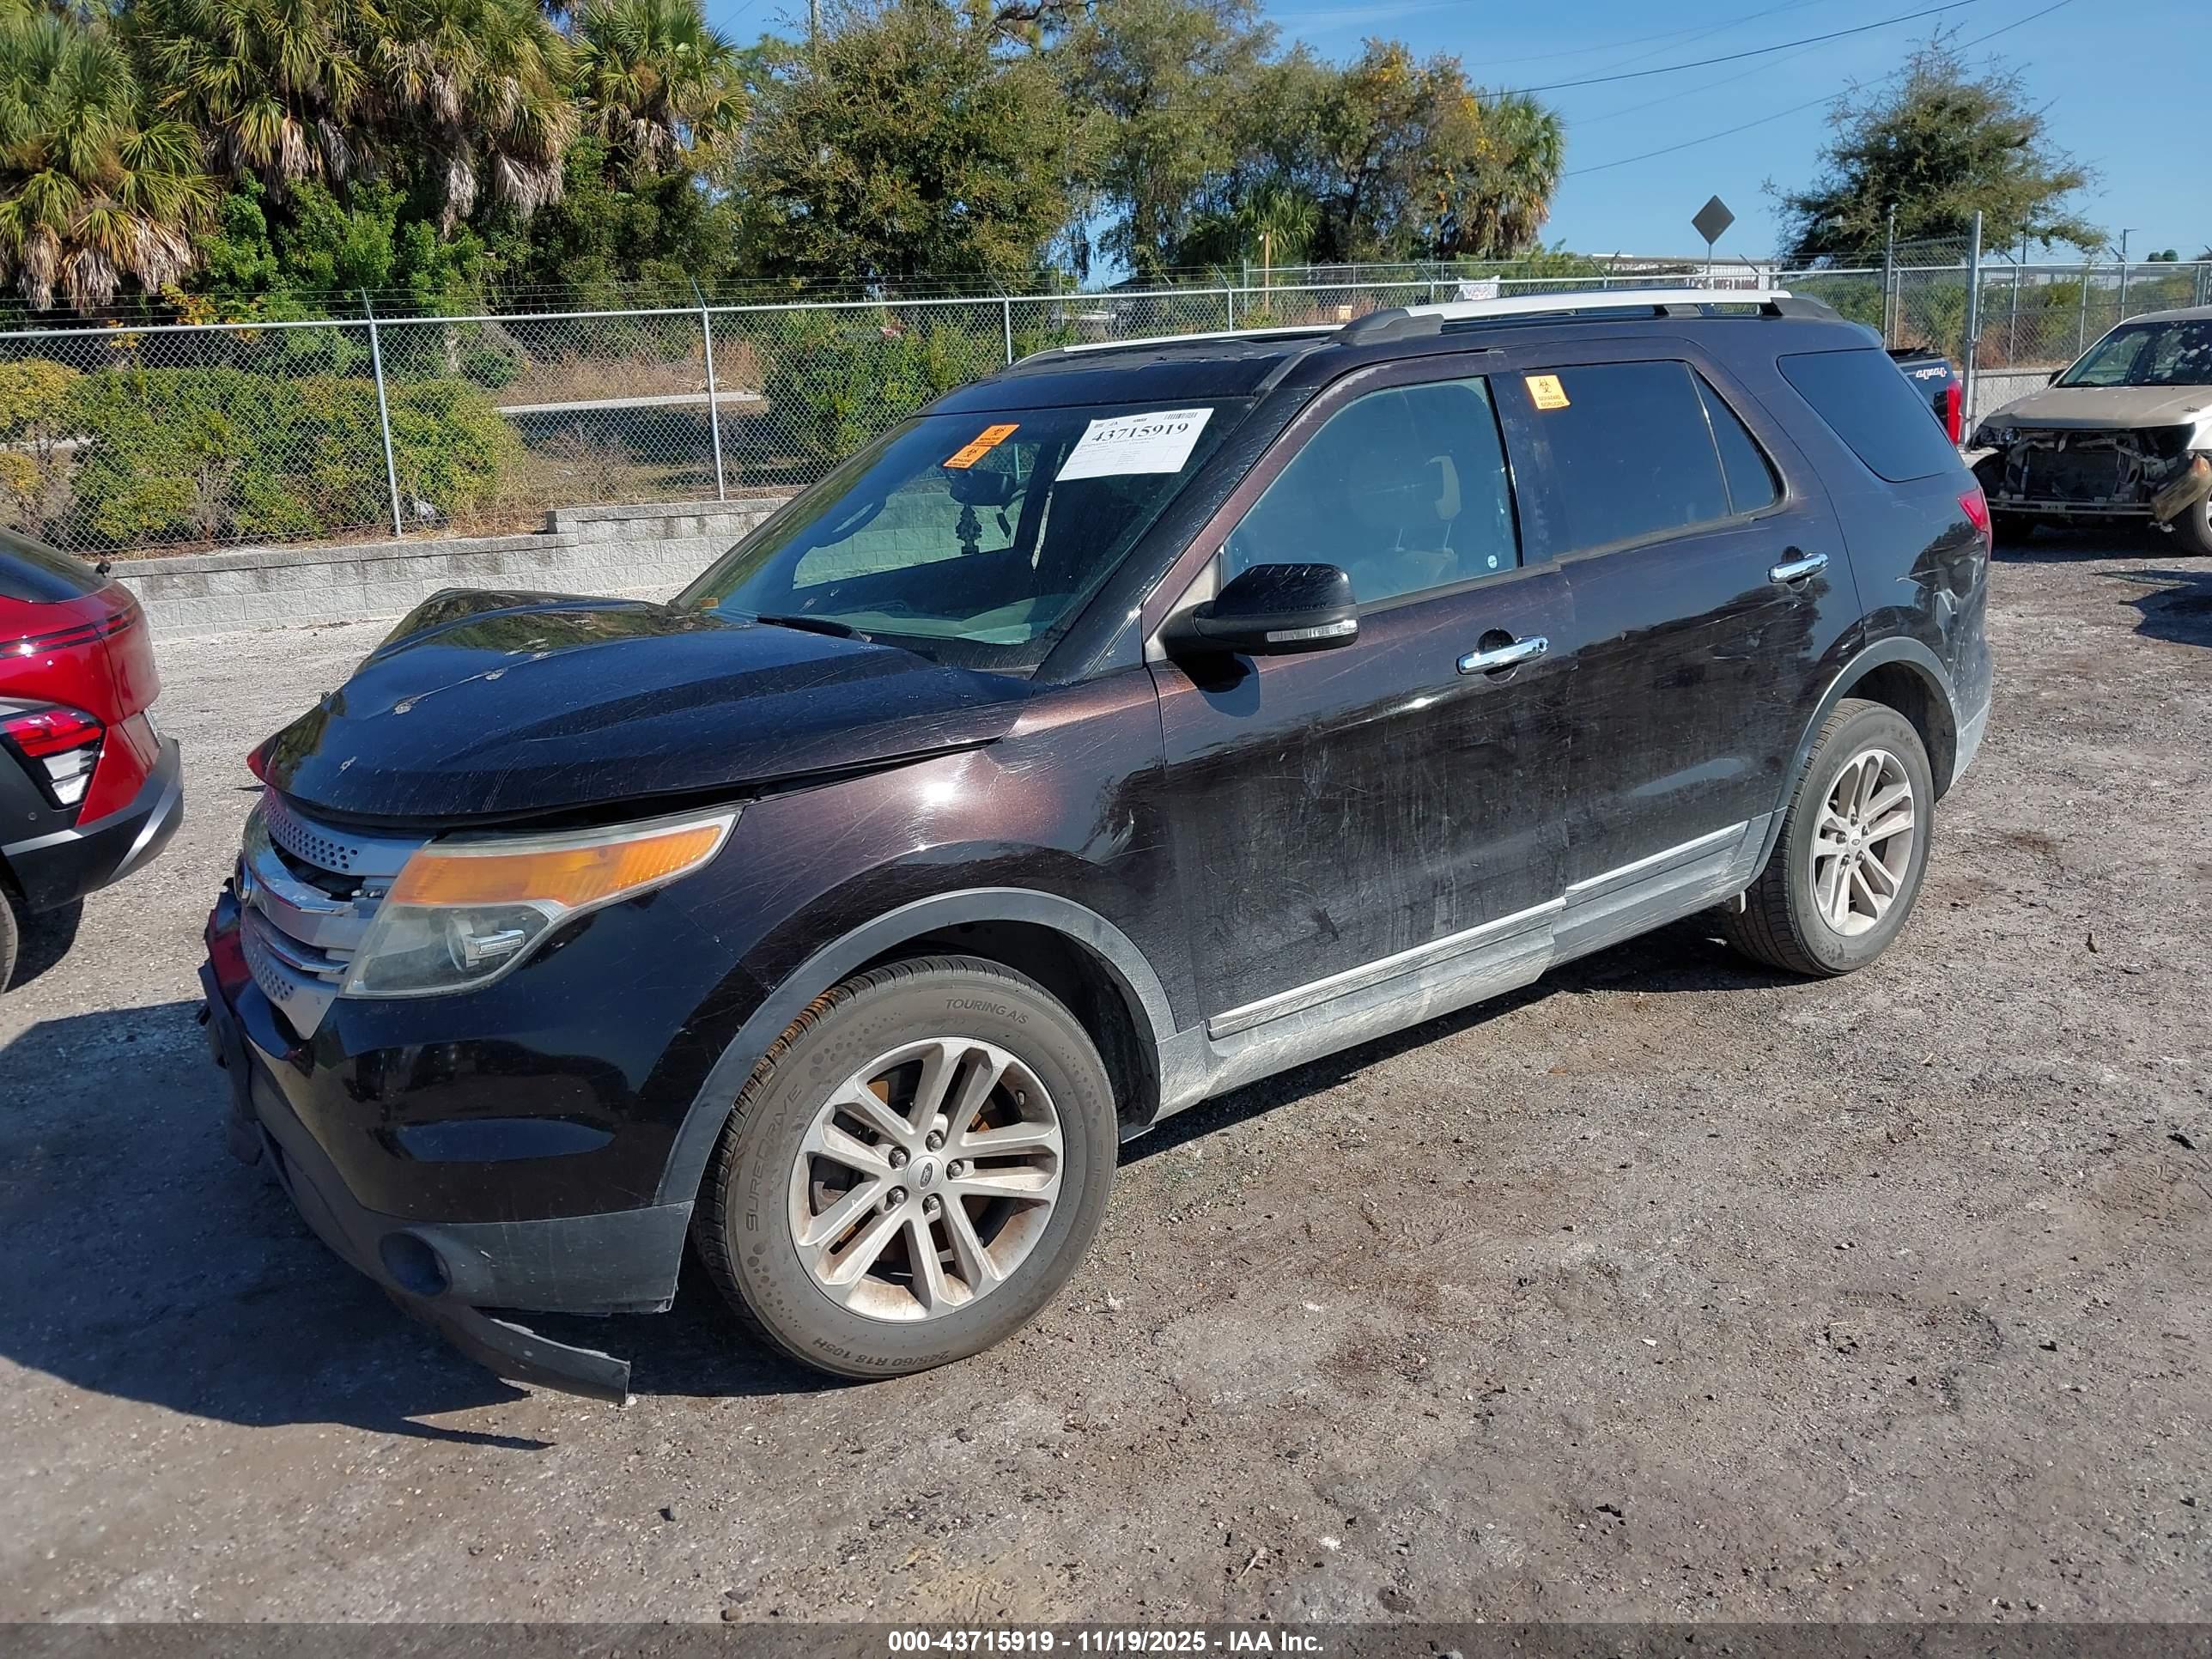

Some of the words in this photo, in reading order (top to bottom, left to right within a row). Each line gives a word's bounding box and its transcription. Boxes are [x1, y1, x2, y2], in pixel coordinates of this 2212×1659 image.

[1091, 423, 1188, 442] 43715919
[945, 999, 1007, 1015] TOURING
[1006, 1010, 1029, 1024] A/S
[746, 1084, 802, 1231] SUREDRIVE
[812, 1337, 852, 1358] 105H
[854, 1354, 888, 1366] R18
